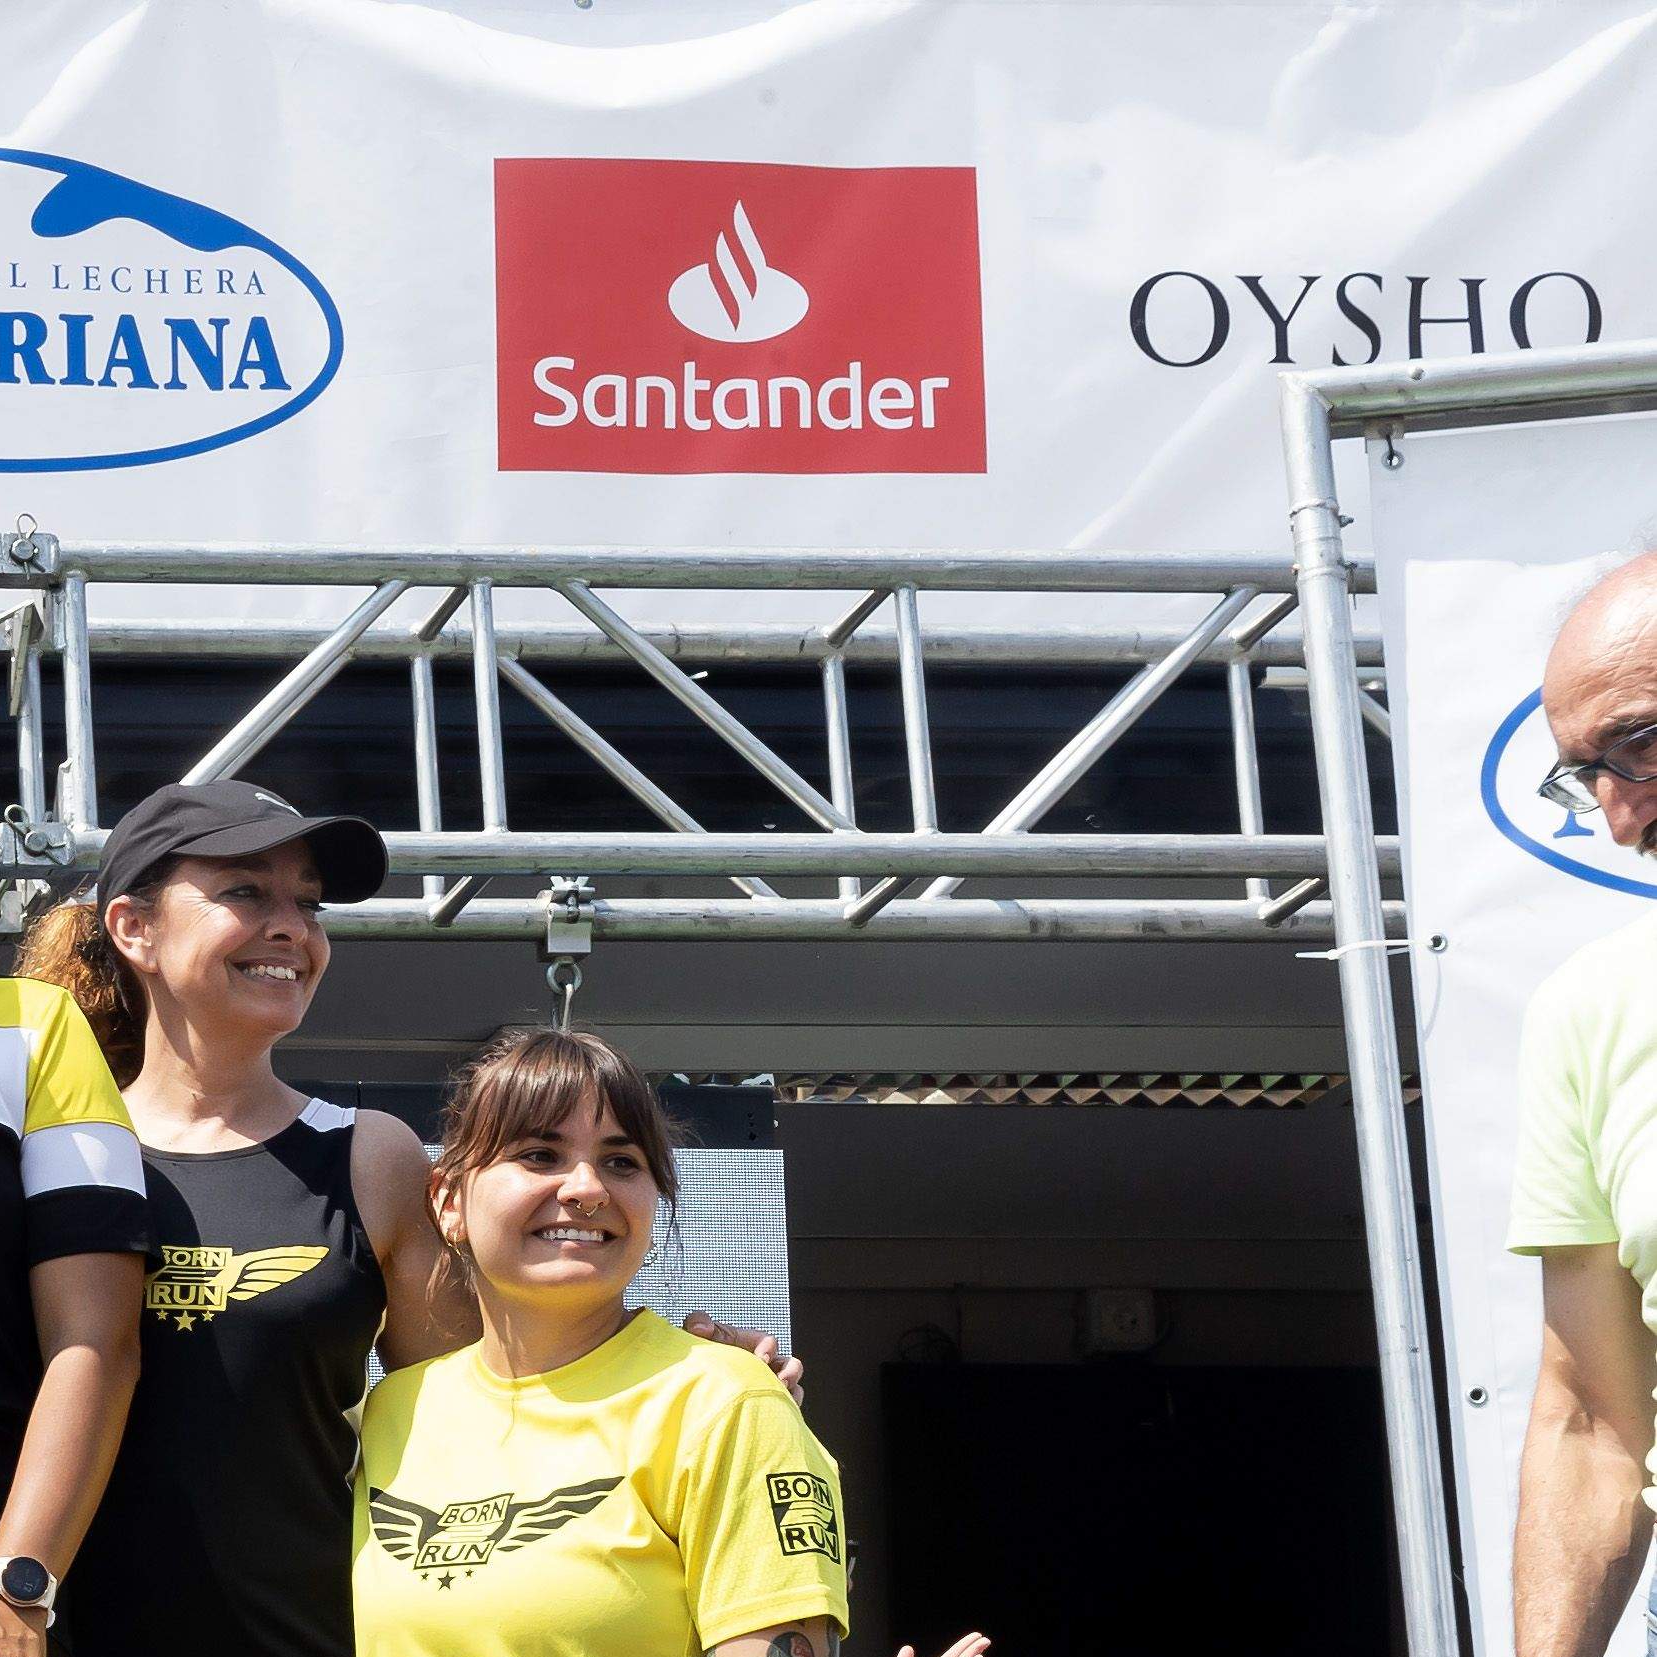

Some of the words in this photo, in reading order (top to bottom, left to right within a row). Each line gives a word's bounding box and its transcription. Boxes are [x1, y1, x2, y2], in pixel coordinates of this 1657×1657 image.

[53, 262, 267, 297] LECHERA
[1129, 270, 1603, 370] OYSHO
[532, 355, 950, 433] Santander
[153, 1284, 223, 1305] RUN
[443, 1499, 506, 1524] BORN
[421, 1543, 492, 1564] RUN
[785, 1525, 838, 1559] RUN
